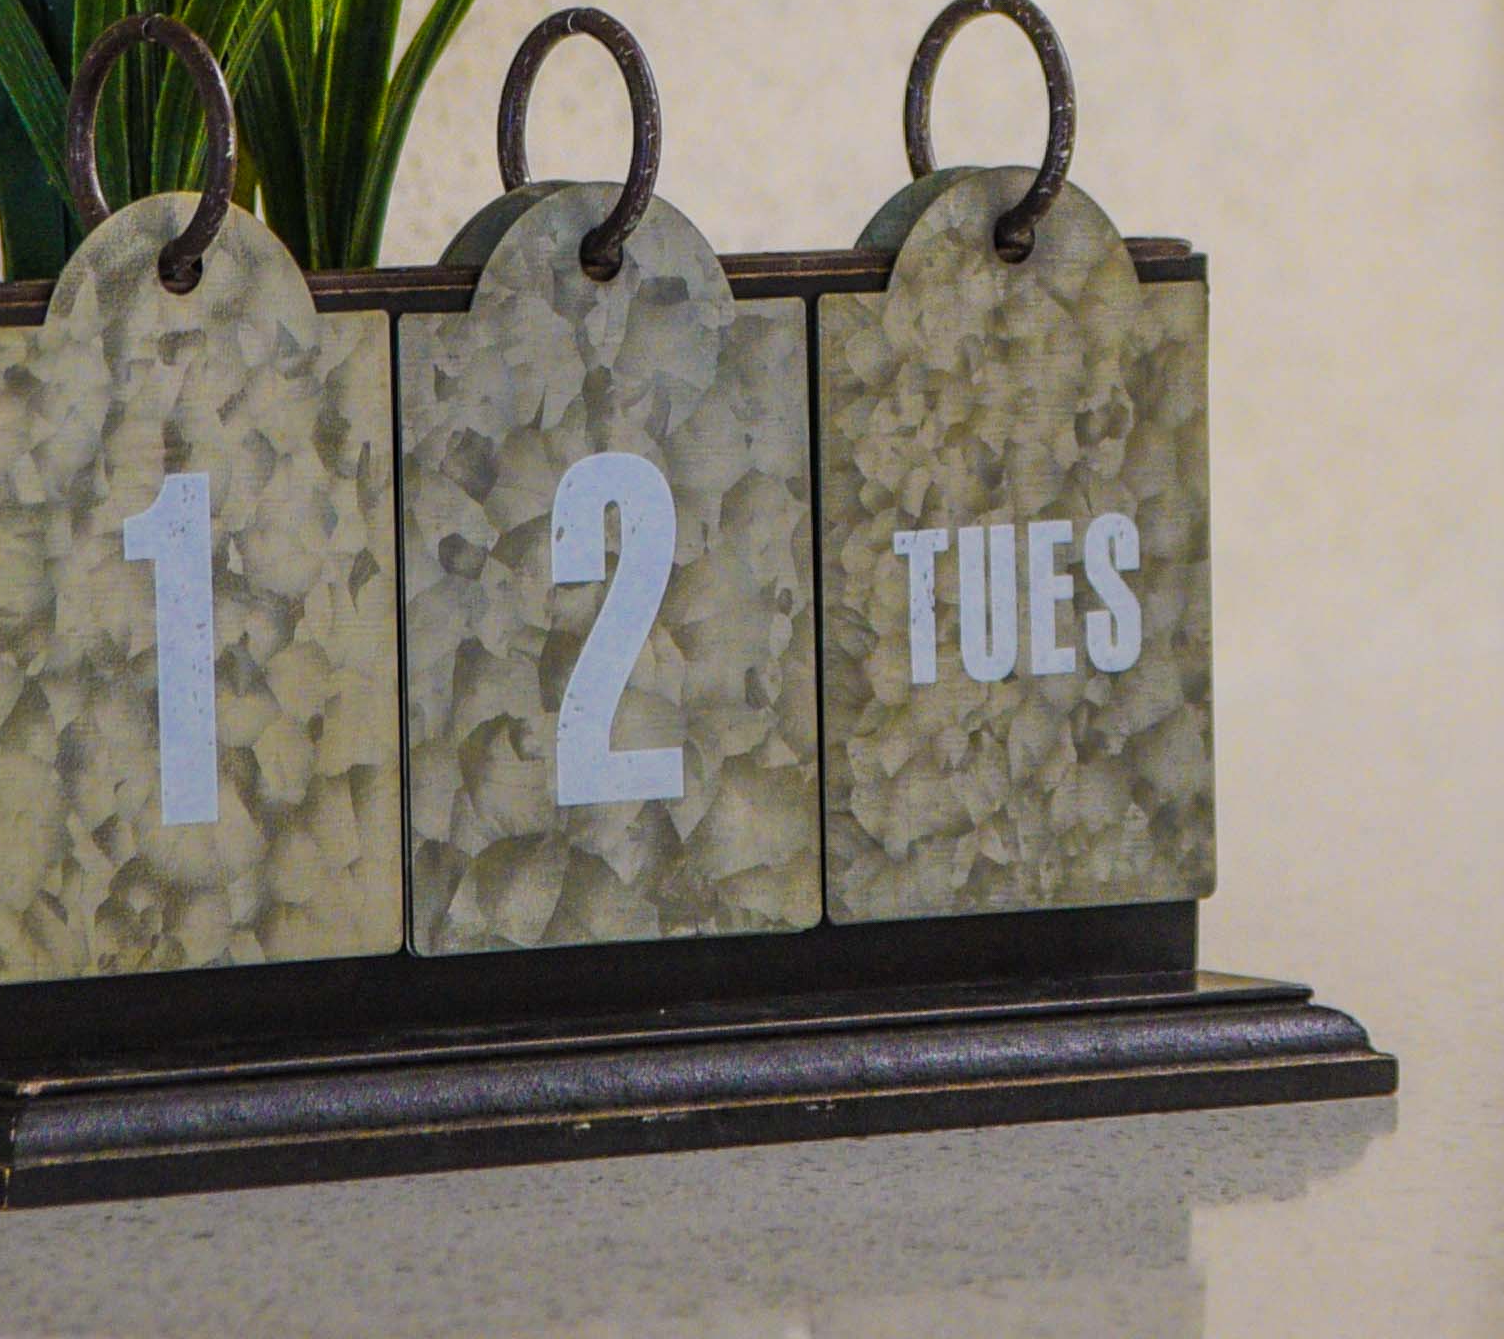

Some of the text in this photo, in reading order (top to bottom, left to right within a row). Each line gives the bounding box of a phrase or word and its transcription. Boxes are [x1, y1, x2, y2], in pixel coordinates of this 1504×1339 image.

[123, 452, 1142, 826] 1 2 TUES
